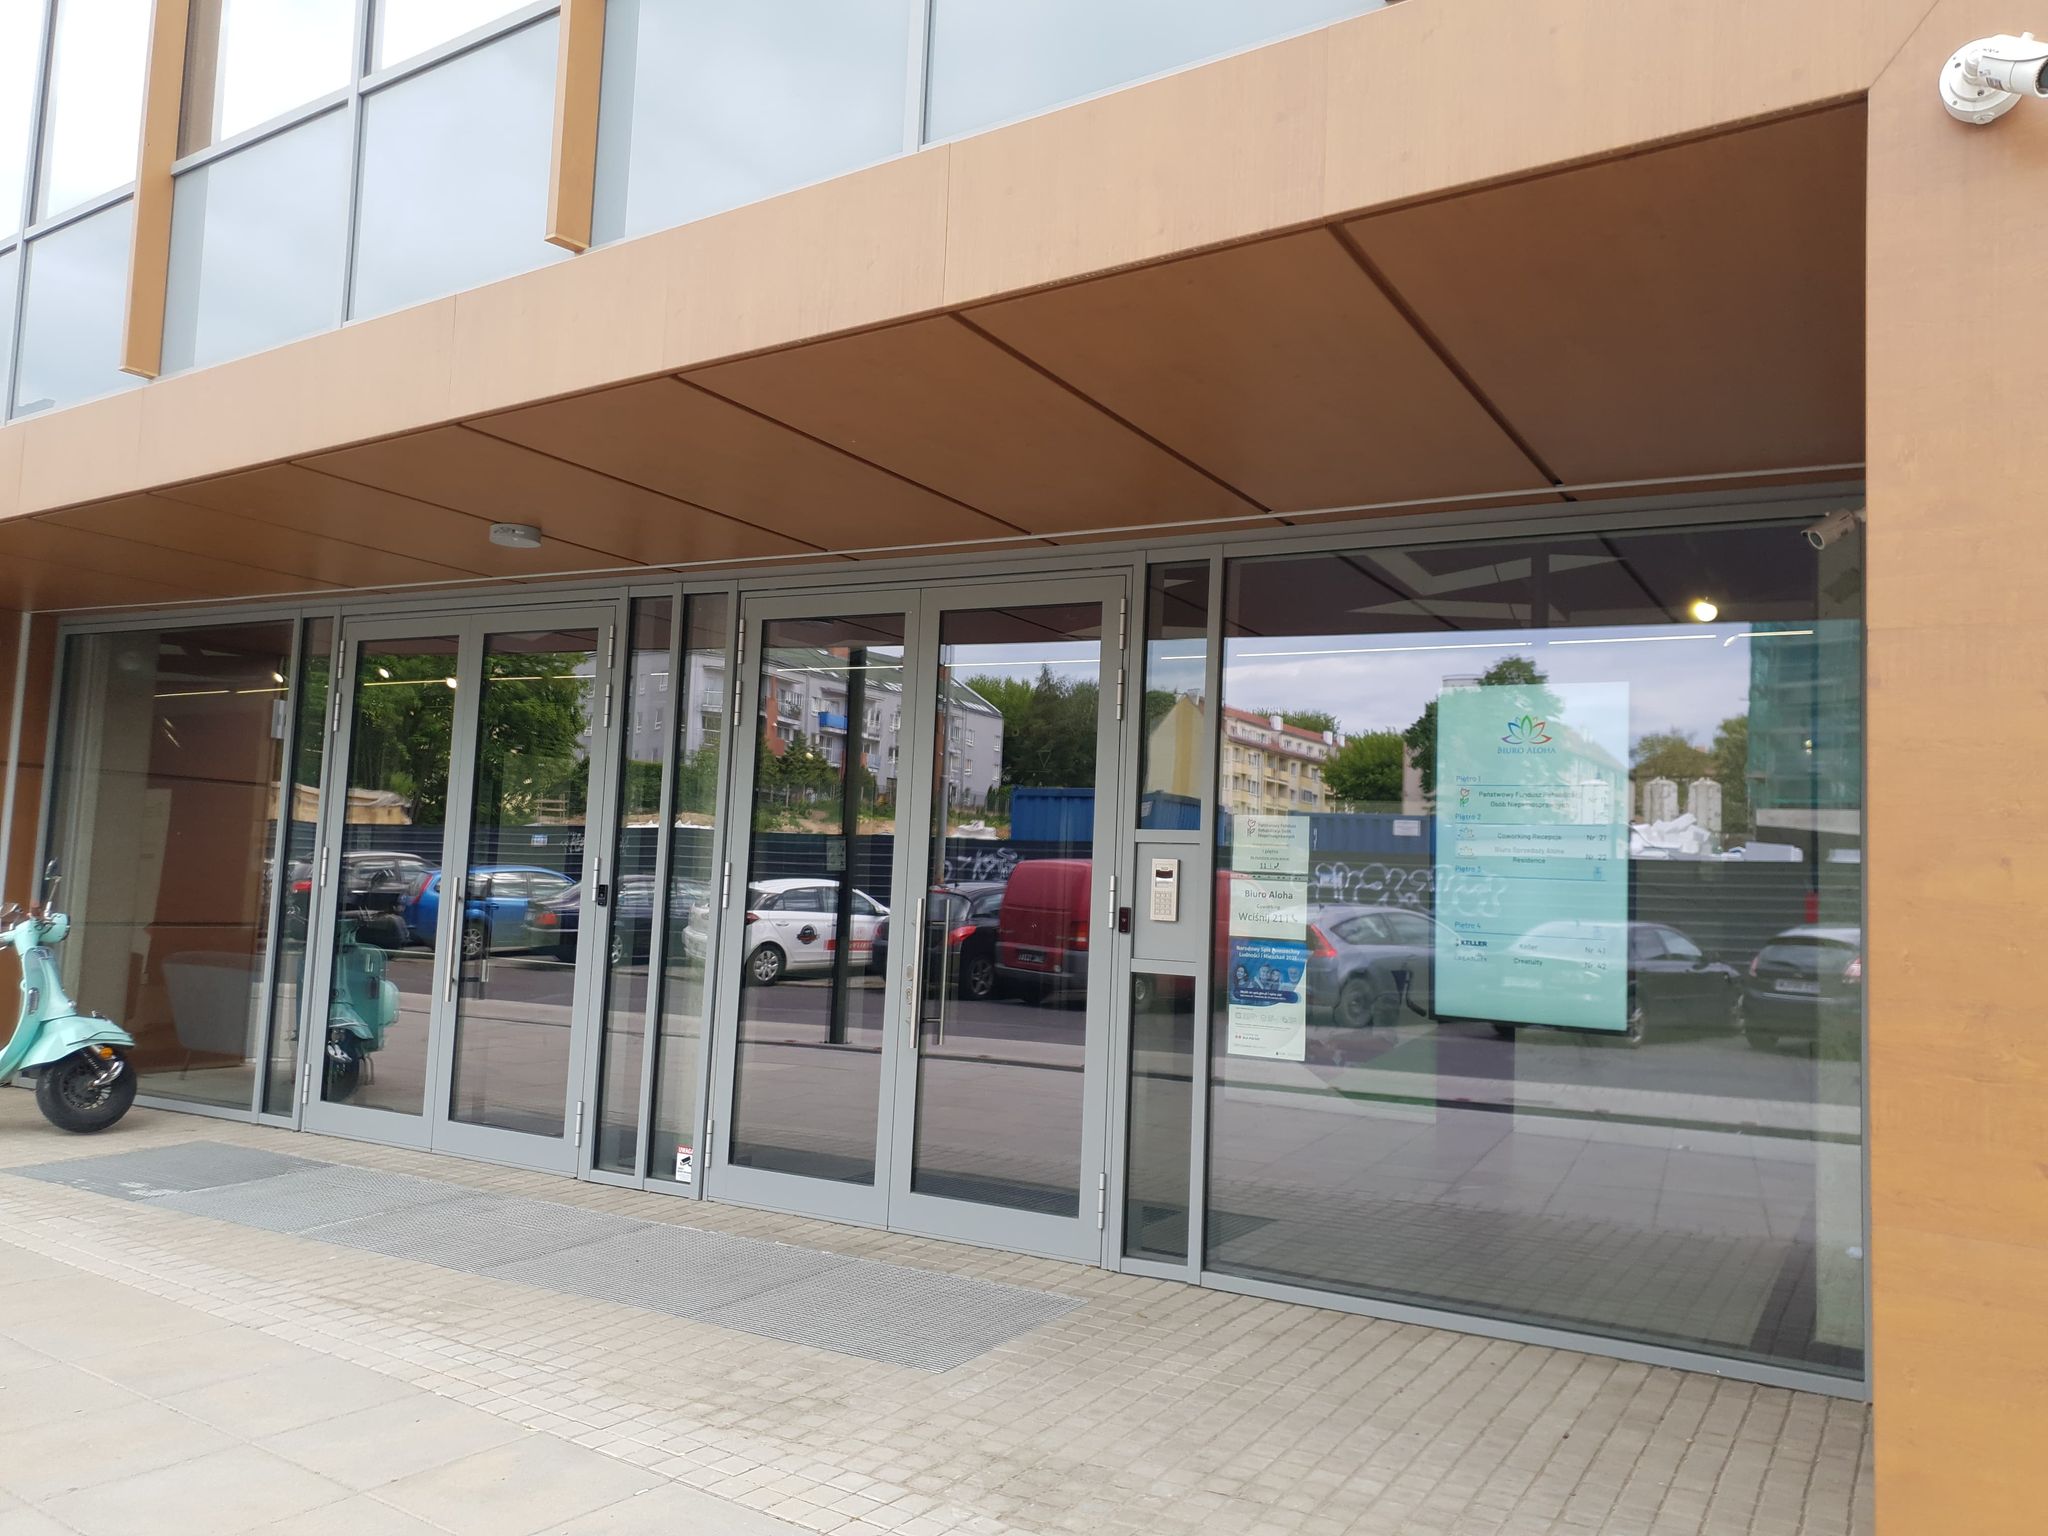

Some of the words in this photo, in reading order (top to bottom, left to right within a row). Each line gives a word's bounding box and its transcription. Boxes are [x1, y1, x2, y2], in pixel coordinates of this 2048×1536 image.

[1456, 775, 1476, 783] Piętro
[1455, 813, 1476, 821] Piętro
[1497, 833, 1531, 841] Coworking
[1455, 865, 1476, 873] Piętro
[1245, 890, 1267, 898] Biuro
[1268, 891, 1293, 900] Aloha
[1238, 912, 1270, 923] Wciśnij
[1272, 914, 1283, 923] 21
[1454, 921, 1475, 929] Piętro
